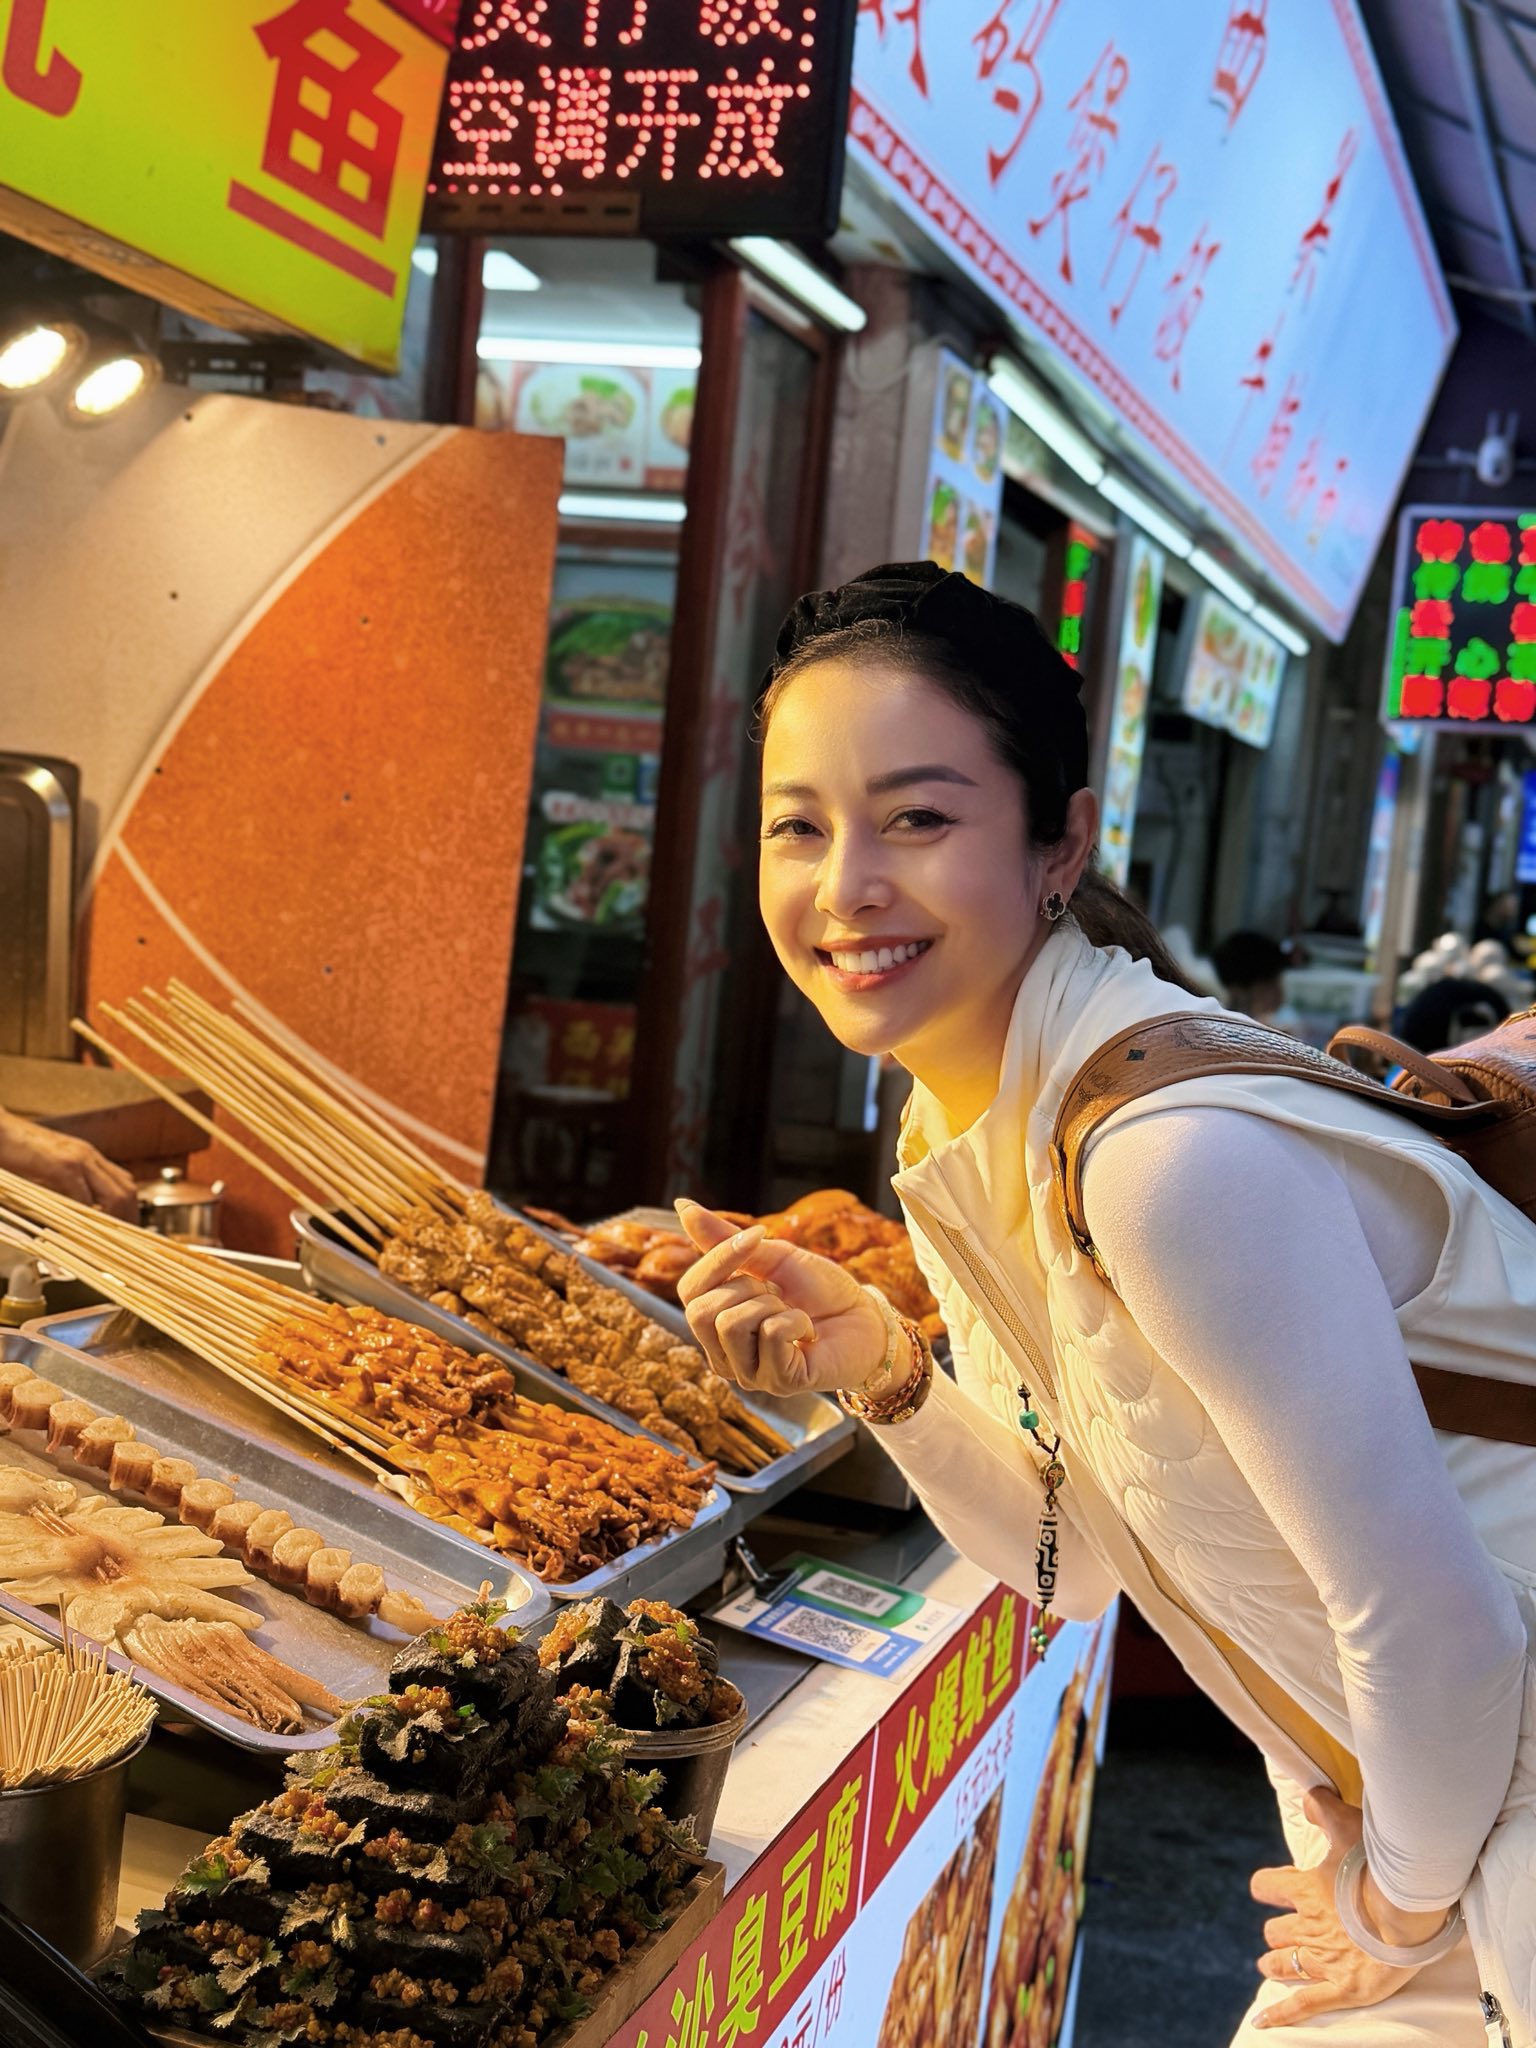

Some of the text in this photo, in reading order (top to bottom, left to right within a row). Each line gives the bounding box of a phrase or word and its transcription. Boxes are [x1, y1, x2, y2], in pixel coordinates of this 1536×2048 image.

[441, 57, 796, 182] 空调开放
[885, 1593, 1016, 1847] 火爆鱿鱼
[635, 1774, 863, 2048] 沙臭豆腐
[780, 1945, 847, 2048] 元/份
